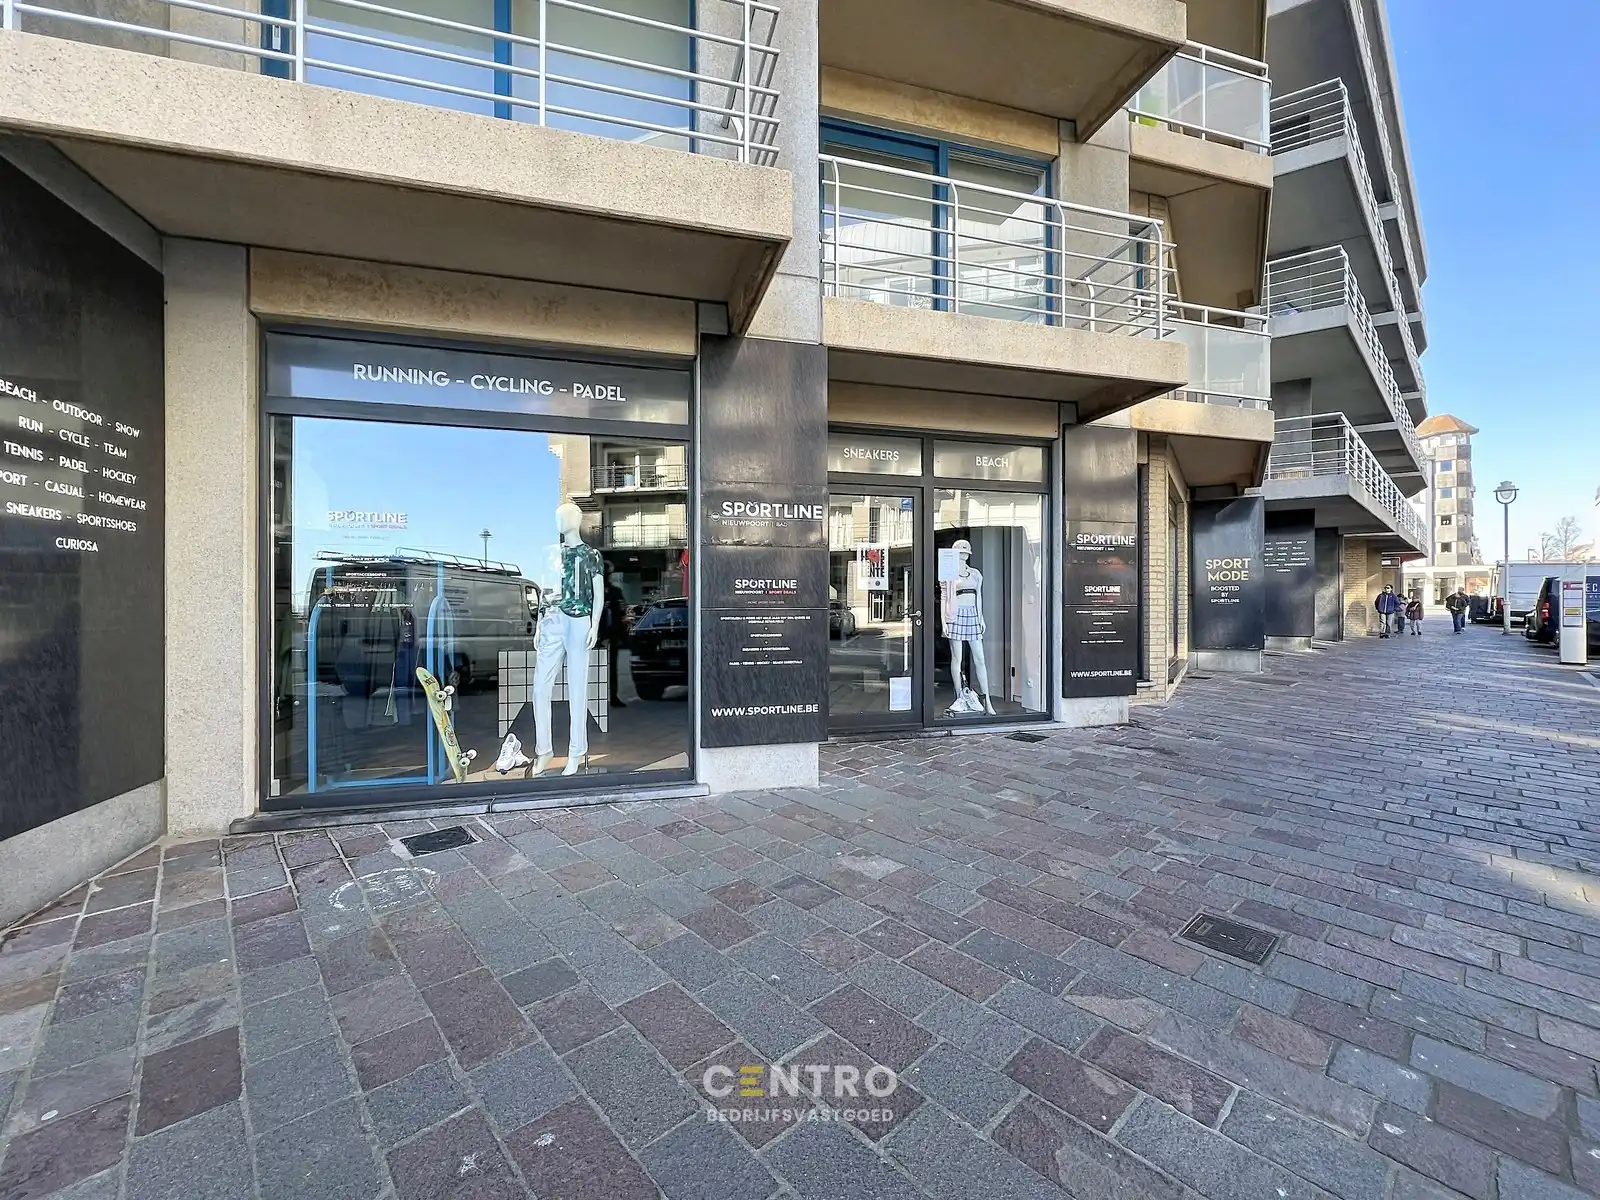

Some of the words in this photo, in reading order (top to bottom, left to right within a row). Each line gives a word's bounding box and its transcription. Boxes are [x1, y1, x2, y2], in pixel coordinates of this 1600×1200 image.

[353, 364, 450, 387] RUNNING
[470, 374, 554, 396] CYCLING
[573, 383, 626, 402] PADEL
[0, 378, 37, 403] BEACH
[53, 400, 103, 427] OUTDOOR
[115, 421, 141, 438] SNOW
[19, 415, 44, 434] RUN
[59, 428, 90, 448] CYCLE
[104, 442, 127, 459] TEAM
[843, 447, 899, 462] SNEAKERS
[975, 456, 1009, 468] BEACH
[4, 441, 44, 462] TENNIS
[60, 456, 89, 473] PADEL
[103, 467, 137, 485] HOCKEY
[45, 480, 85, 498] CASUAL
[99, 491, 146, 511] HOMEWEAR
[6, 501, 62, 521] SNEAKERS
[77, 513, 137, 532] SPORTSSHOES
[56, 537, 99, 552] CURIOSA
[1205, 558, 1251, 570] SPORT
[1207, 571, 1249, 582] MODE
[1071, 670, 1133, 678] WWW.SPORTLINE.BE
[711, 704, 819, 717] WWW.SPORTLINE.BE
